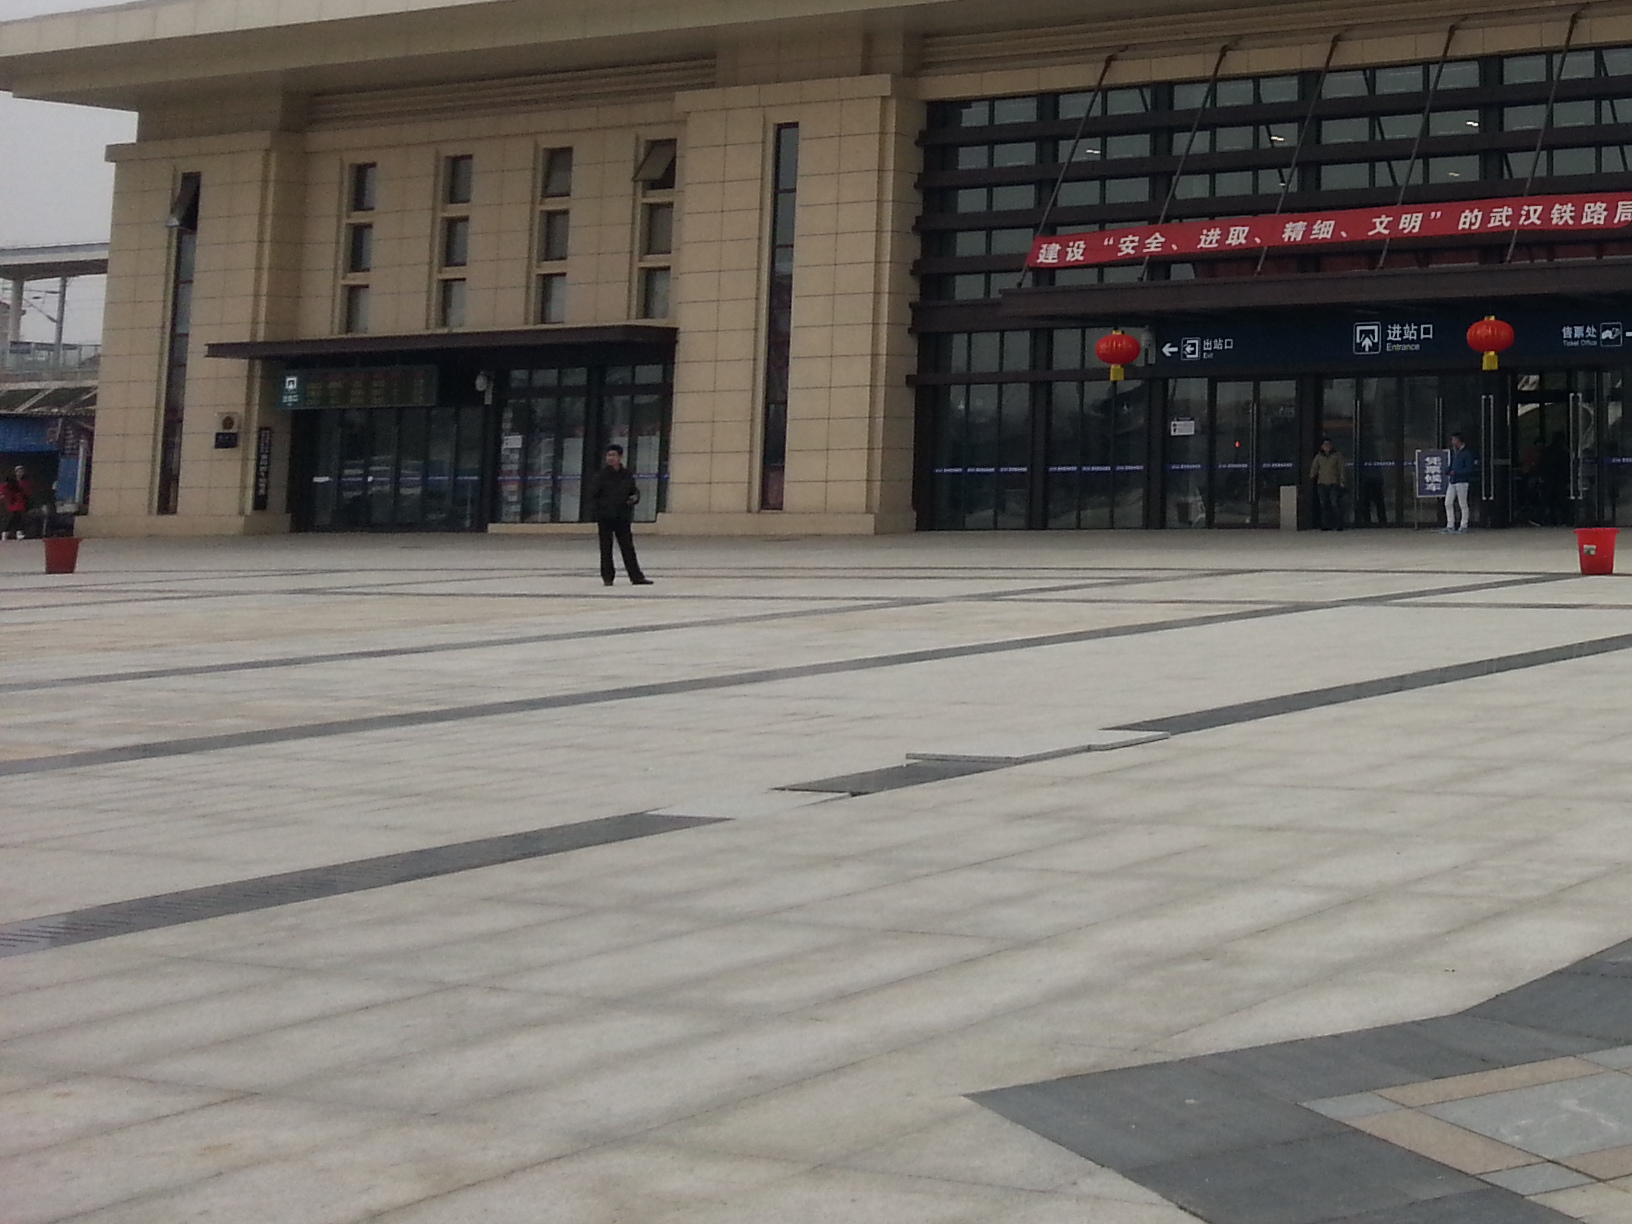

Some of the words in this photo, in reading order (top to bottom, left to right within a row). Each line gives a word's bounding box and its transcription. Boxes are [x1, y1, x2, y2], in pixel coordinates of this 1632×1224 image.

[1386, 322, 1433, 341] 进站口
[1562, 324, 1597, 339] 售票处
[1203, 337, 1233, 351] 出站口
[1386, 342, 1420, 352] Entrance
